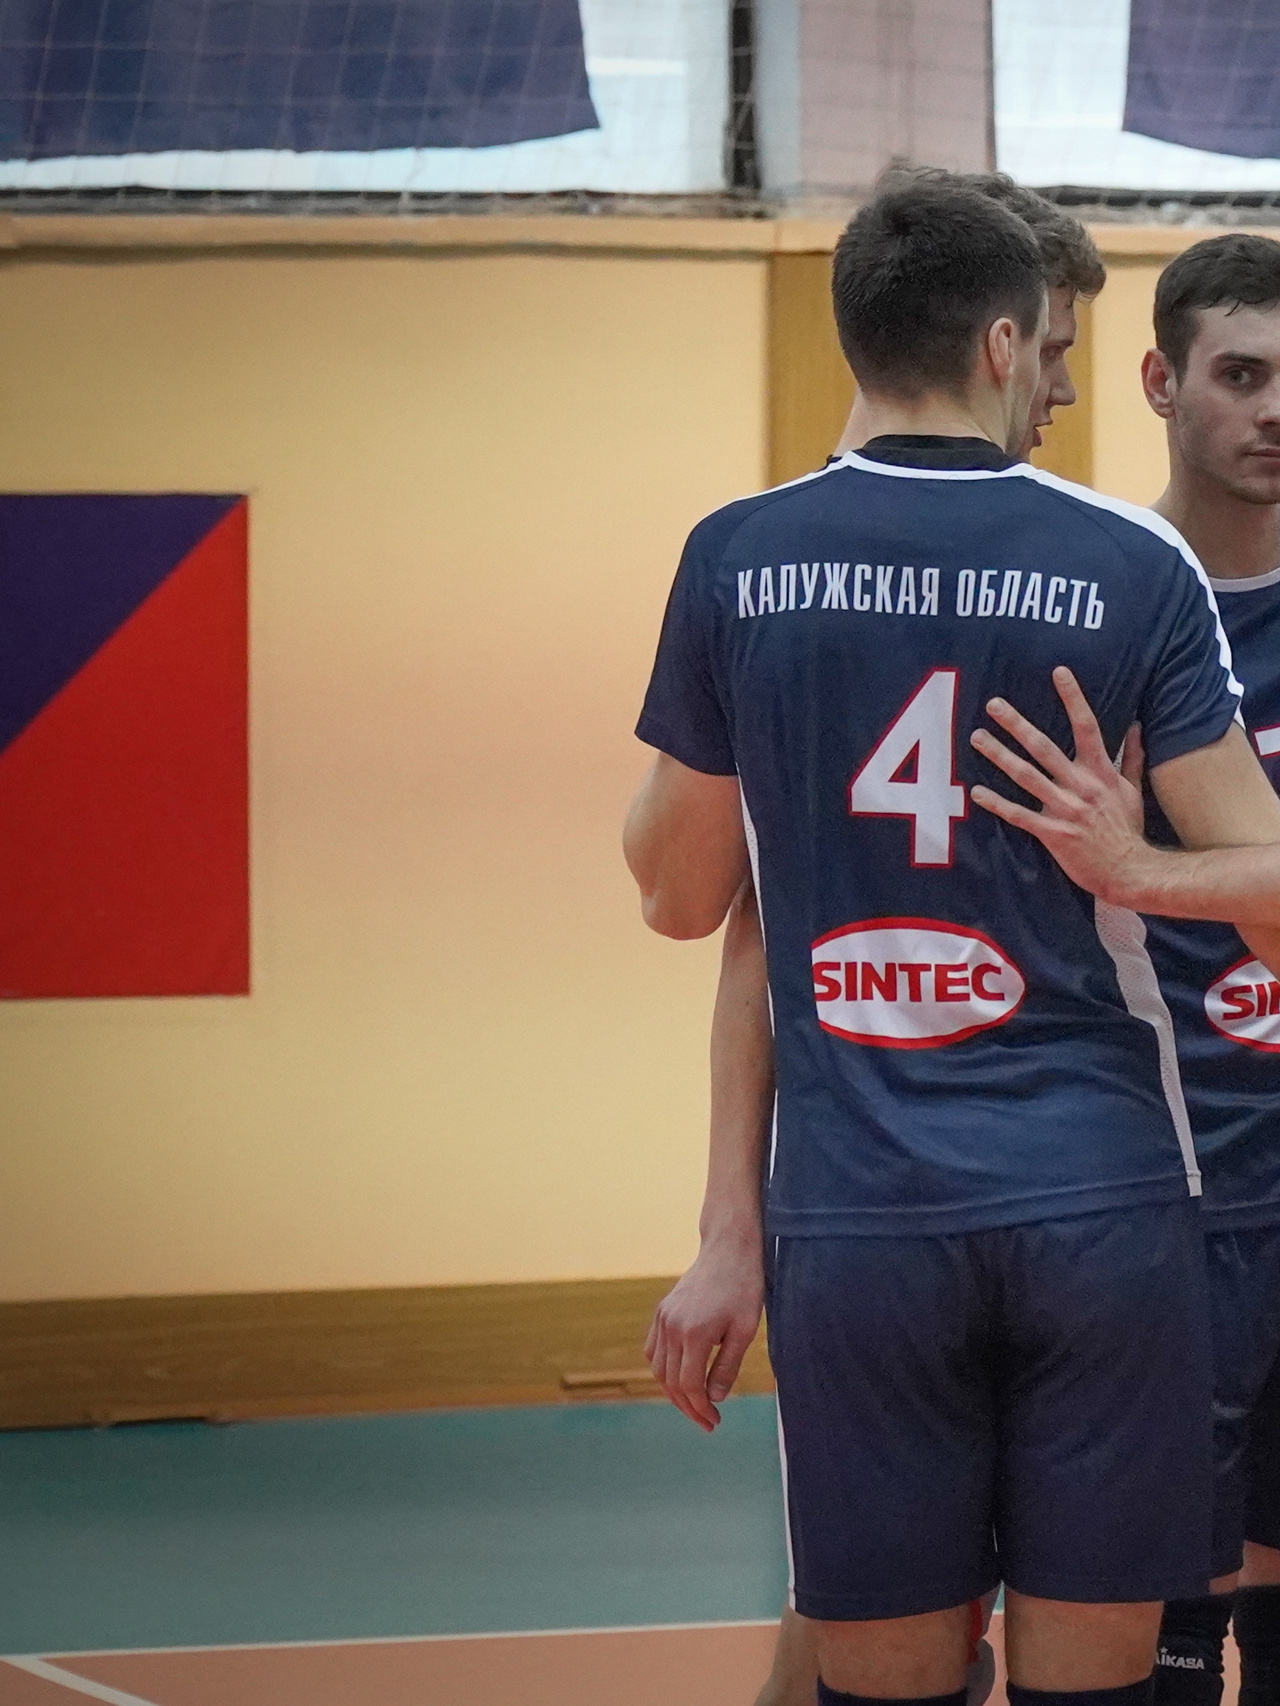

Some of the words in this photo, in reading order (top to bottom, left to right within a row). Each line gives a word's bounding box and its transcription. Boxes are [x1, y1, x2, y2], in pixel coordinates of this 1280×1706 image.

[737, 562, 940, 618] КАЛУЖСКАЯ
[956, 569, 1106, 630] ОБЛАСТЬ
[849, 667, 965, 868] 4
[812, 961, 1005, 1002] SINTEC
